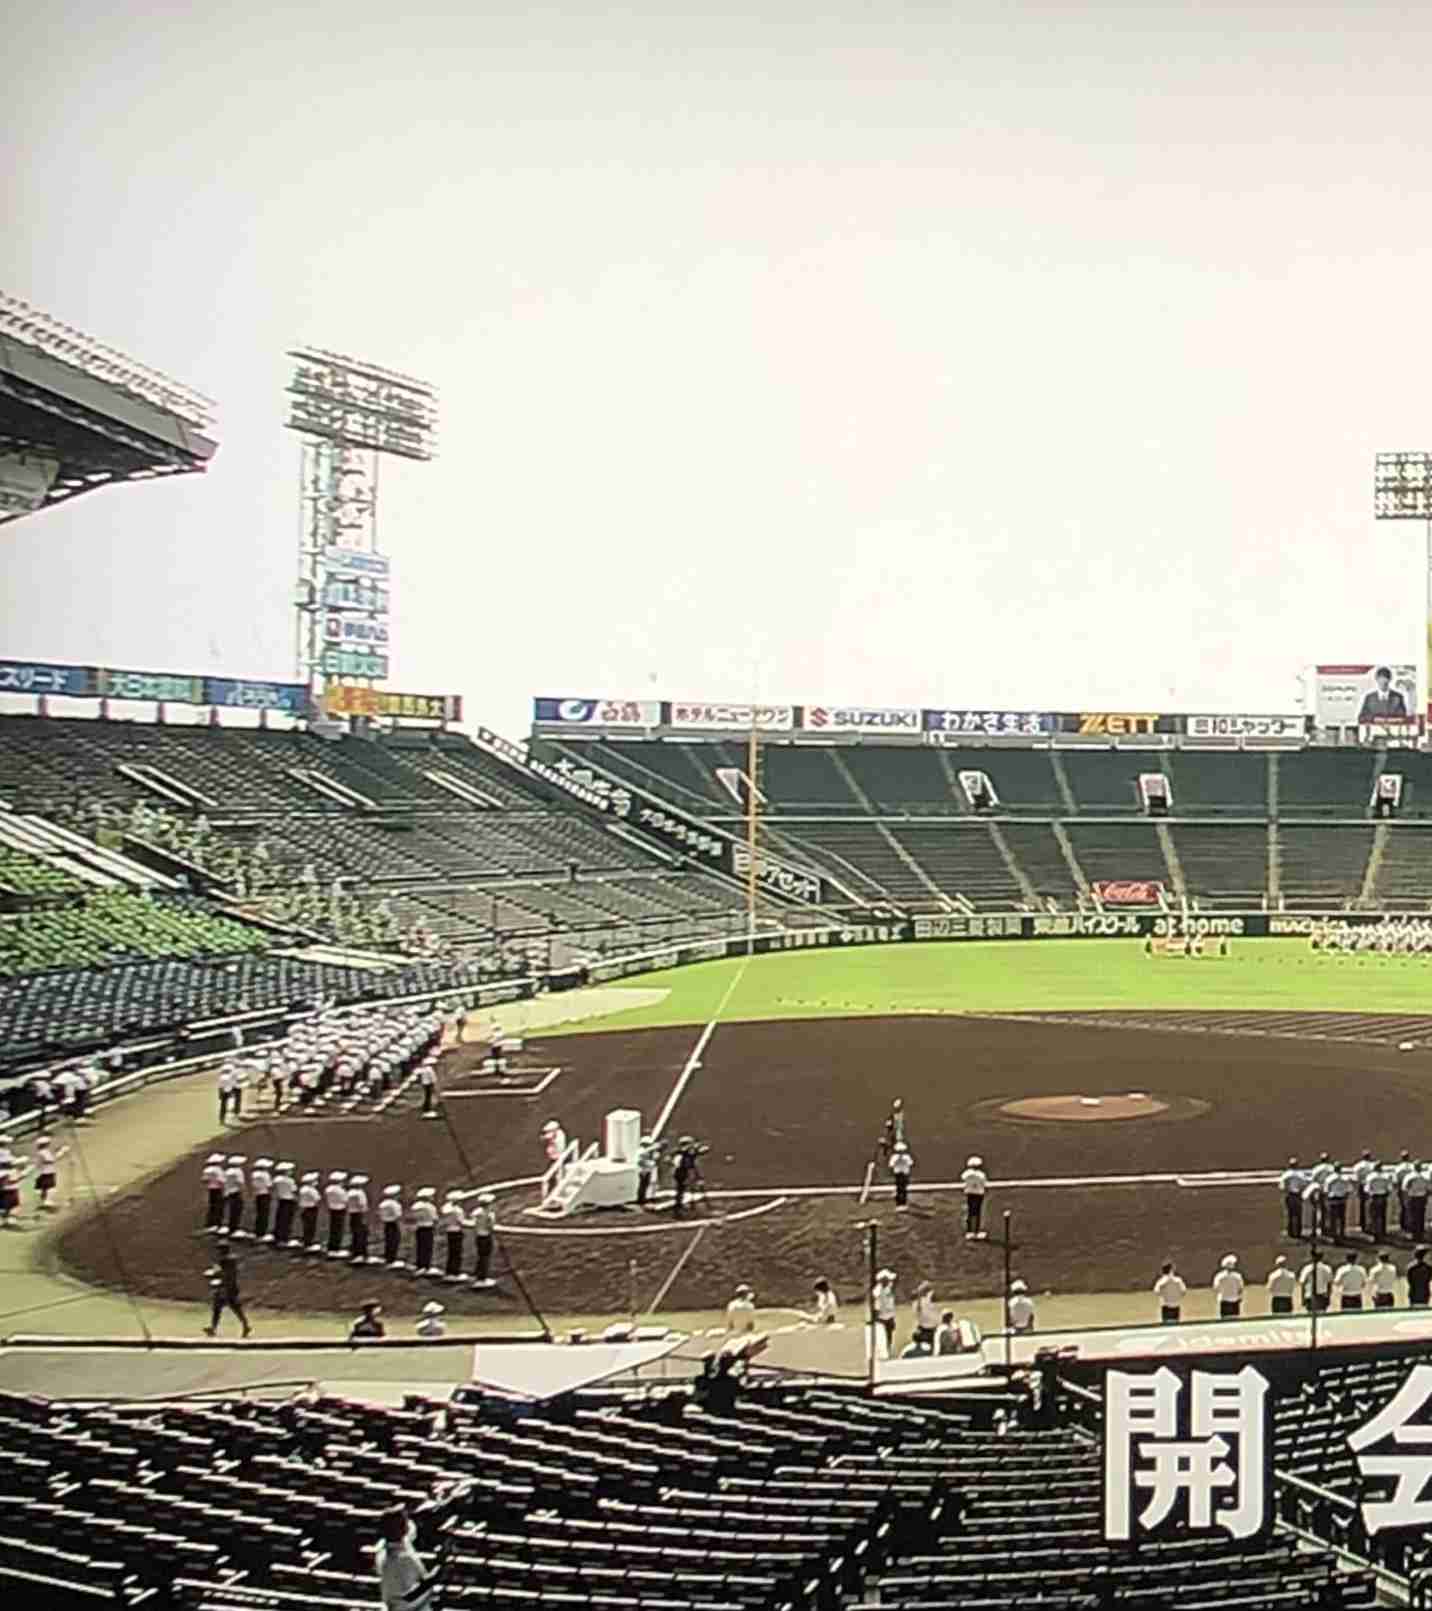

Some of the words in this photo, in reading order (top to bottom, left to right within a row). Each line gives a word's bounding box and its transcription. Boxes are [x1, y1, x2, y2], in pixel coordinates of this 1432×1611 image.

[833, 710, 919, 728] SUZUKI
[1153, 916, 1177, 934] at
[1181, 915, 1244, 934] home
